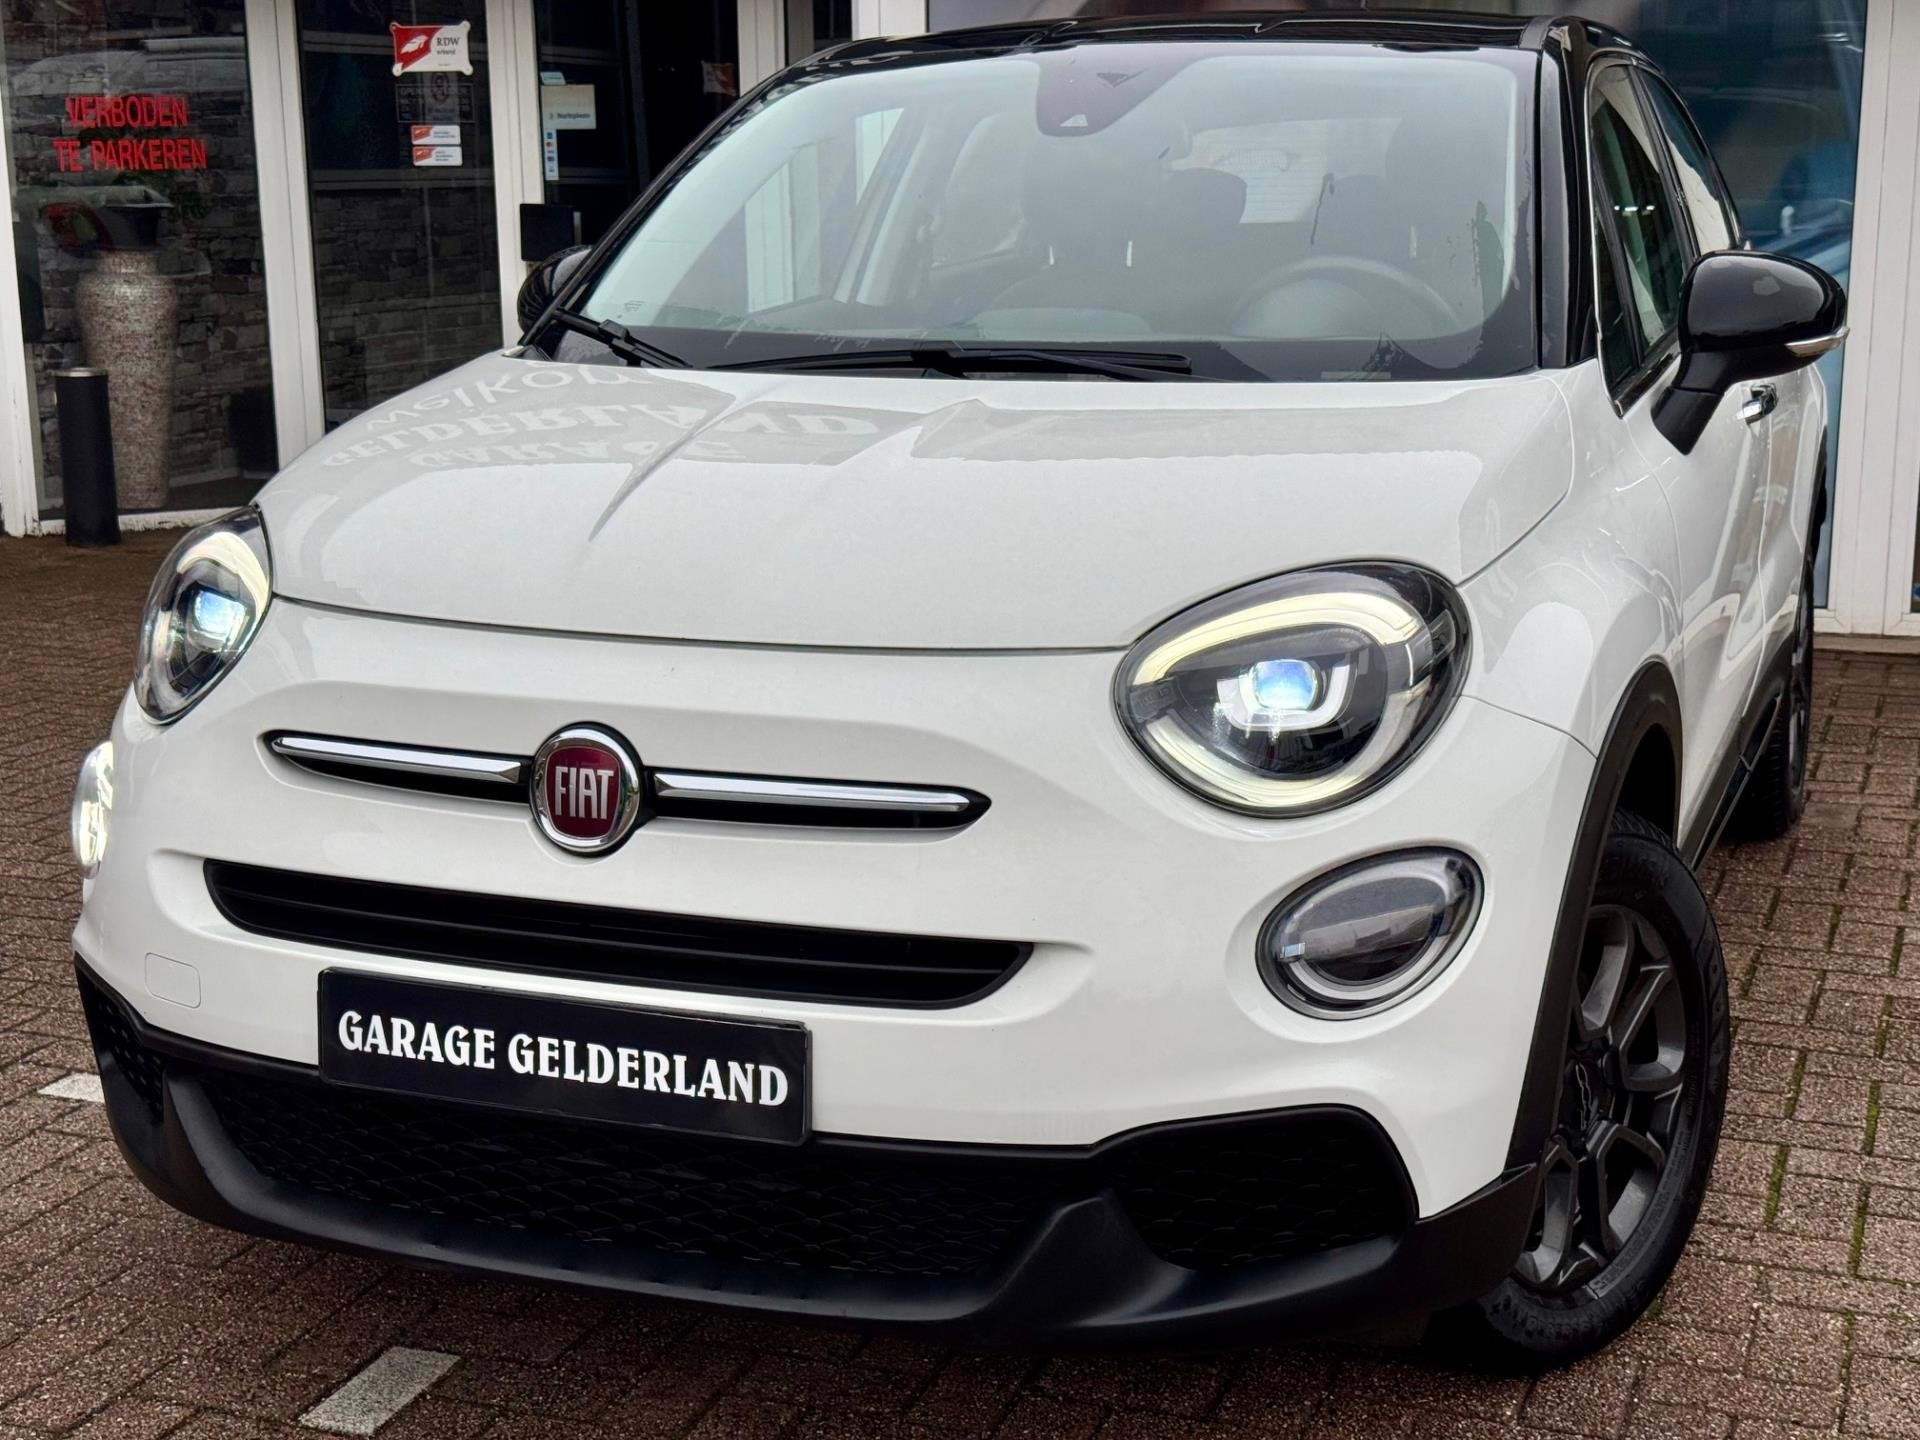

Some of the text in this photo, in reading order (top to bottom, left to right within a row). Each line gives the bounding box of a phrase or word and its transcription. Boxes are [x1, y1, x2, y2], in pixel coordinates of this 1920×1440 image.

[436, 37, 460, 47] RDW
[65, 95, 188, 128] VERBODEN
[53, 139, 209, 172] TE PARKEREN
[555, 766, 615, 820] FIAT
[338, 1010, 790, 1107] GARAGE GELDERLAND
